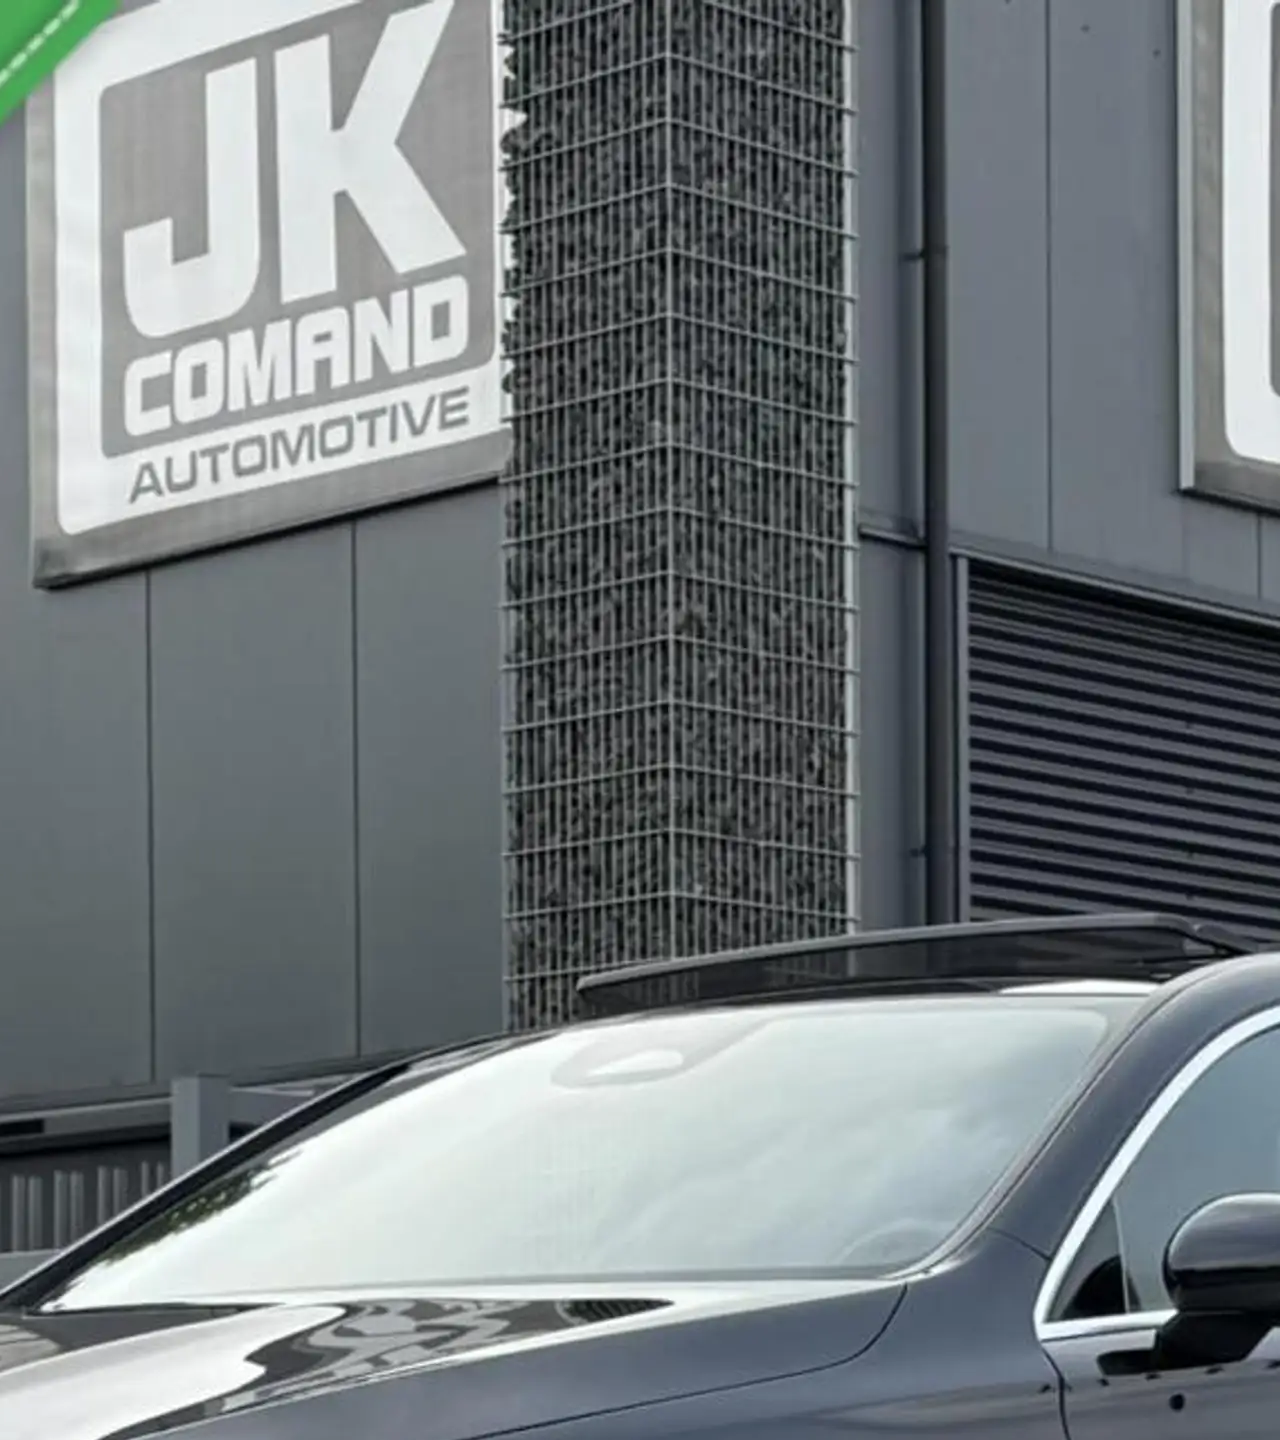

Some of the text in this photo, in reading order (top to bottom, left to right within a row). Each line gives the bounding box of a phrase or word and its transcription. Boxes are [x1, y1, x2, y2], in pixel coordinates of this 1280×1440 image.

[123, 0, 467, 337] JK
[124, 274, 469, 437] COMAND
[129, 386, 470, 503] AUTOMOTIVE
